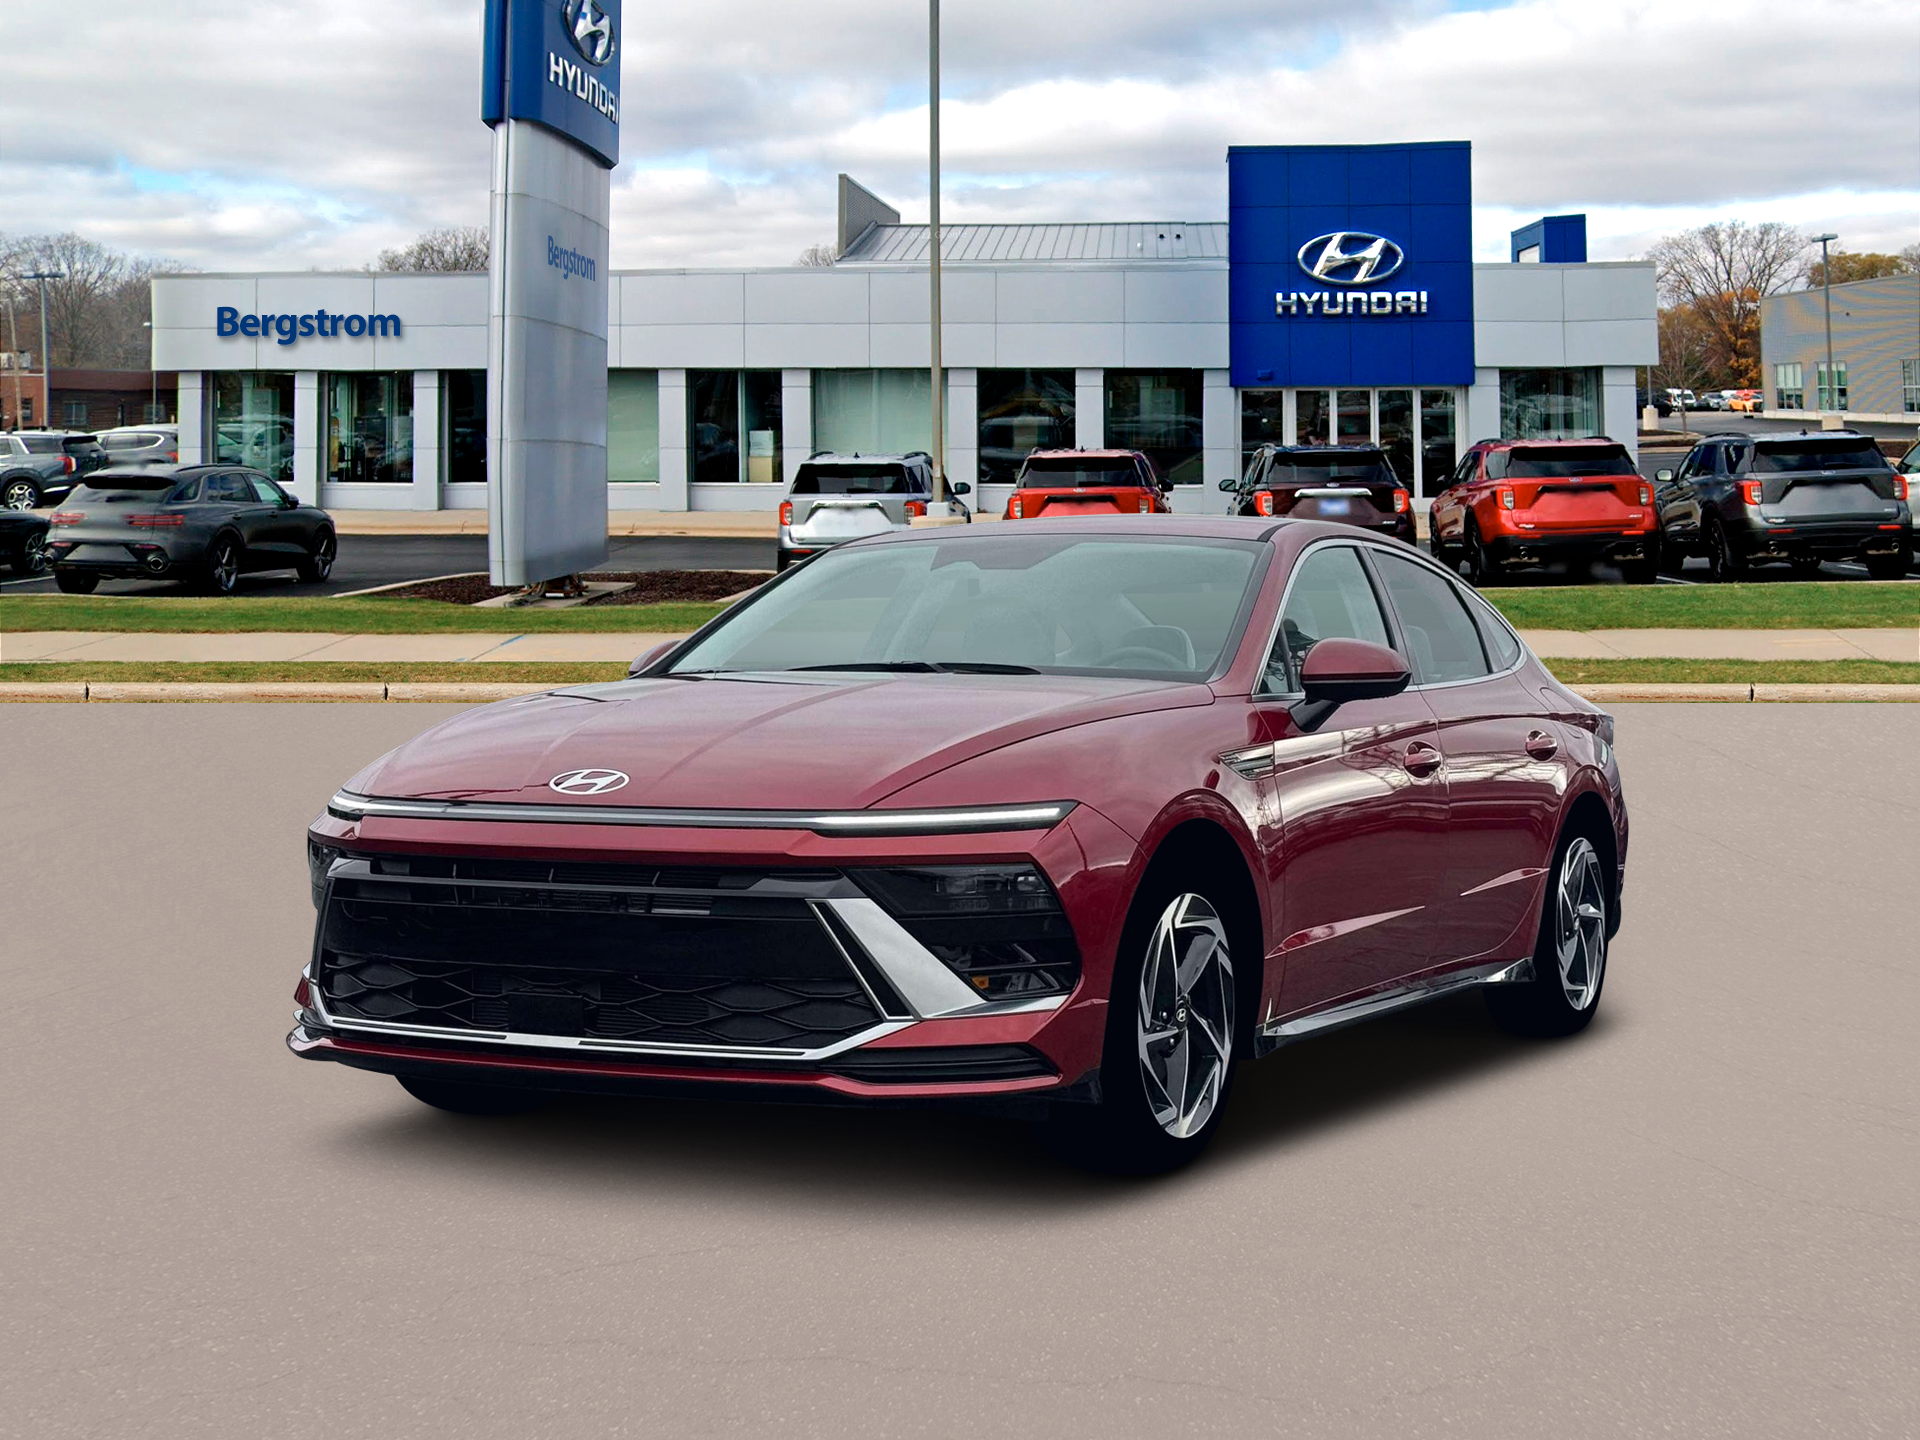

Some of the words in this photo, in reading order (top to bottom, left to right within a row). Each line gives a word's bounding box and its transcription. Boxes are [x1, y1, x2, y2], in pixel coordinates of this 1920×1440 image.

[547, 234, 596, 282] Bergstrom
[1275, 290, 1428, 315] HYUNDAI
[216, 306, 401, 346] Bergstrom
